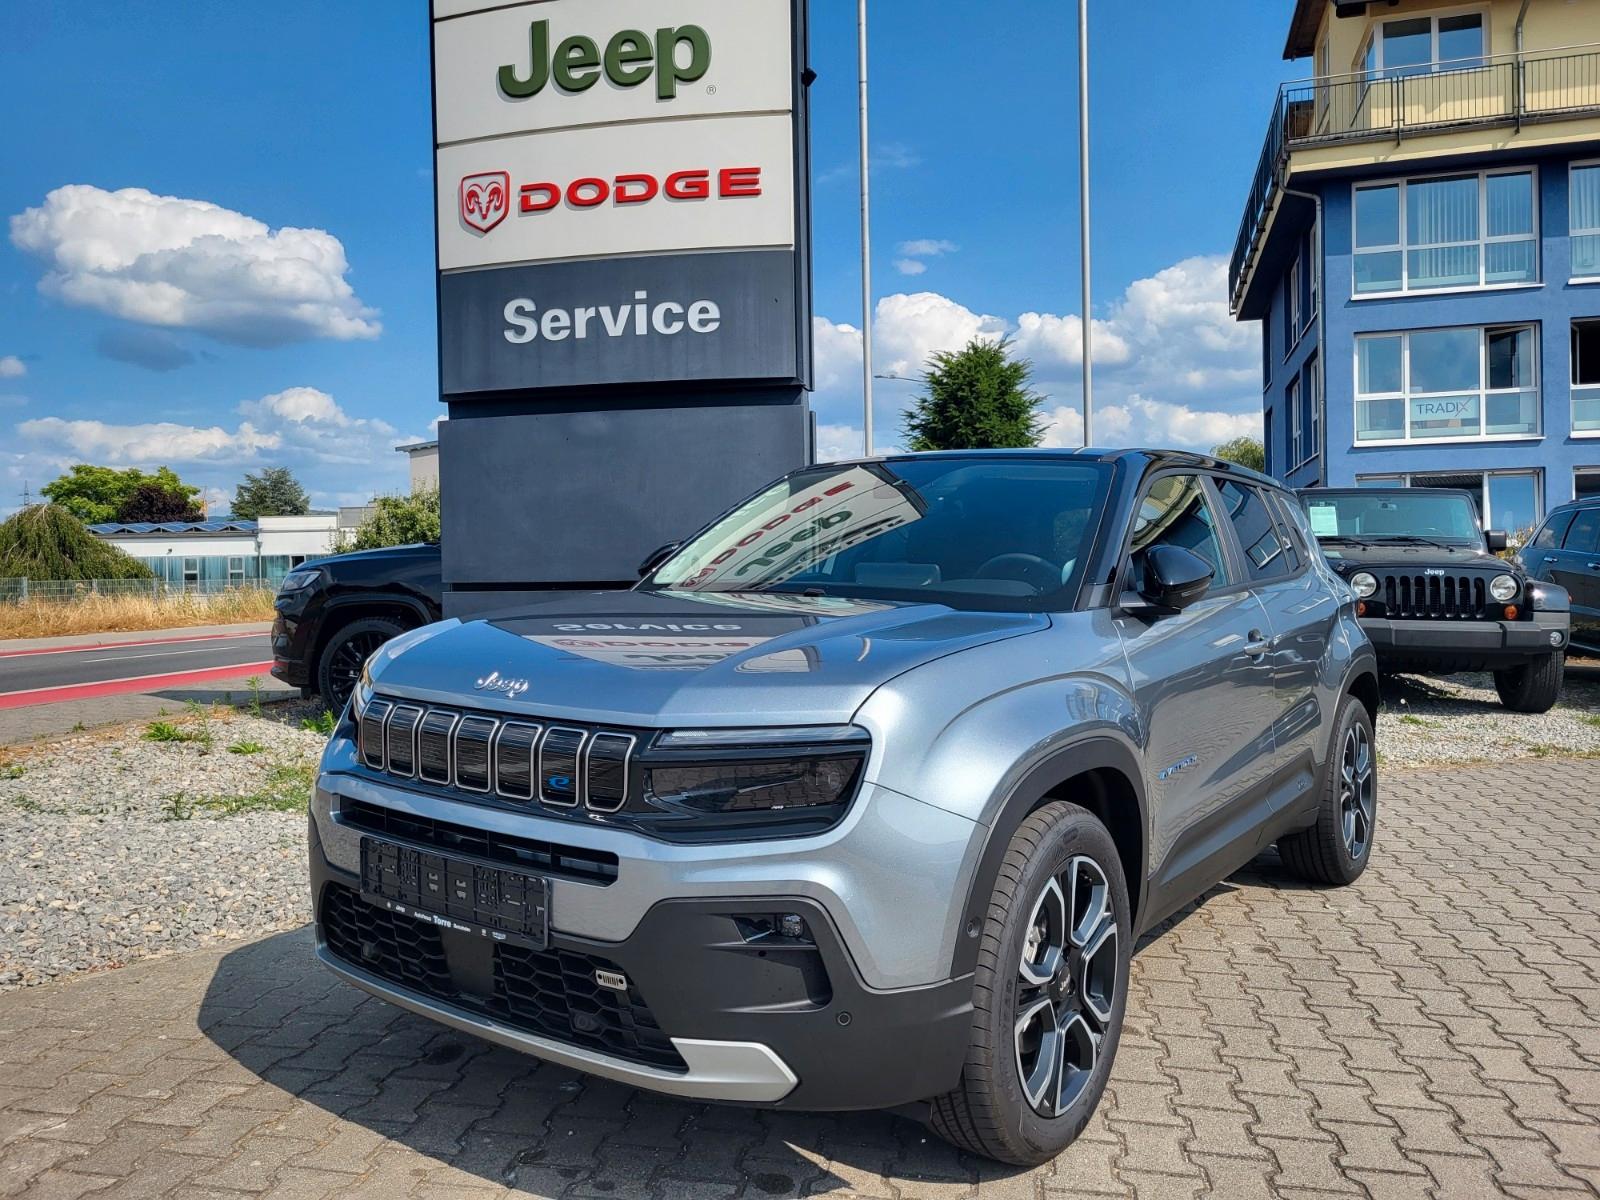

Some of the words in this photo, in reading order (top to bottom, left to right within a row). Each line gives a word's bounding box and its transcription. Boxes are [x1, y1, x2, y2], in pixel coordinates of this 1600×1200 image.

[498, 20, 711, 99] Jeep
[519, 167, 762, 213] DODGE
[503, 290, 722, 344] Service
[1415, 397, 1472, 417] TRADIX
[1424, 568, 1445, 577] Jeep
[475, 671, 529, 697] Jeep
[432, 914, 452, 928] Torre
